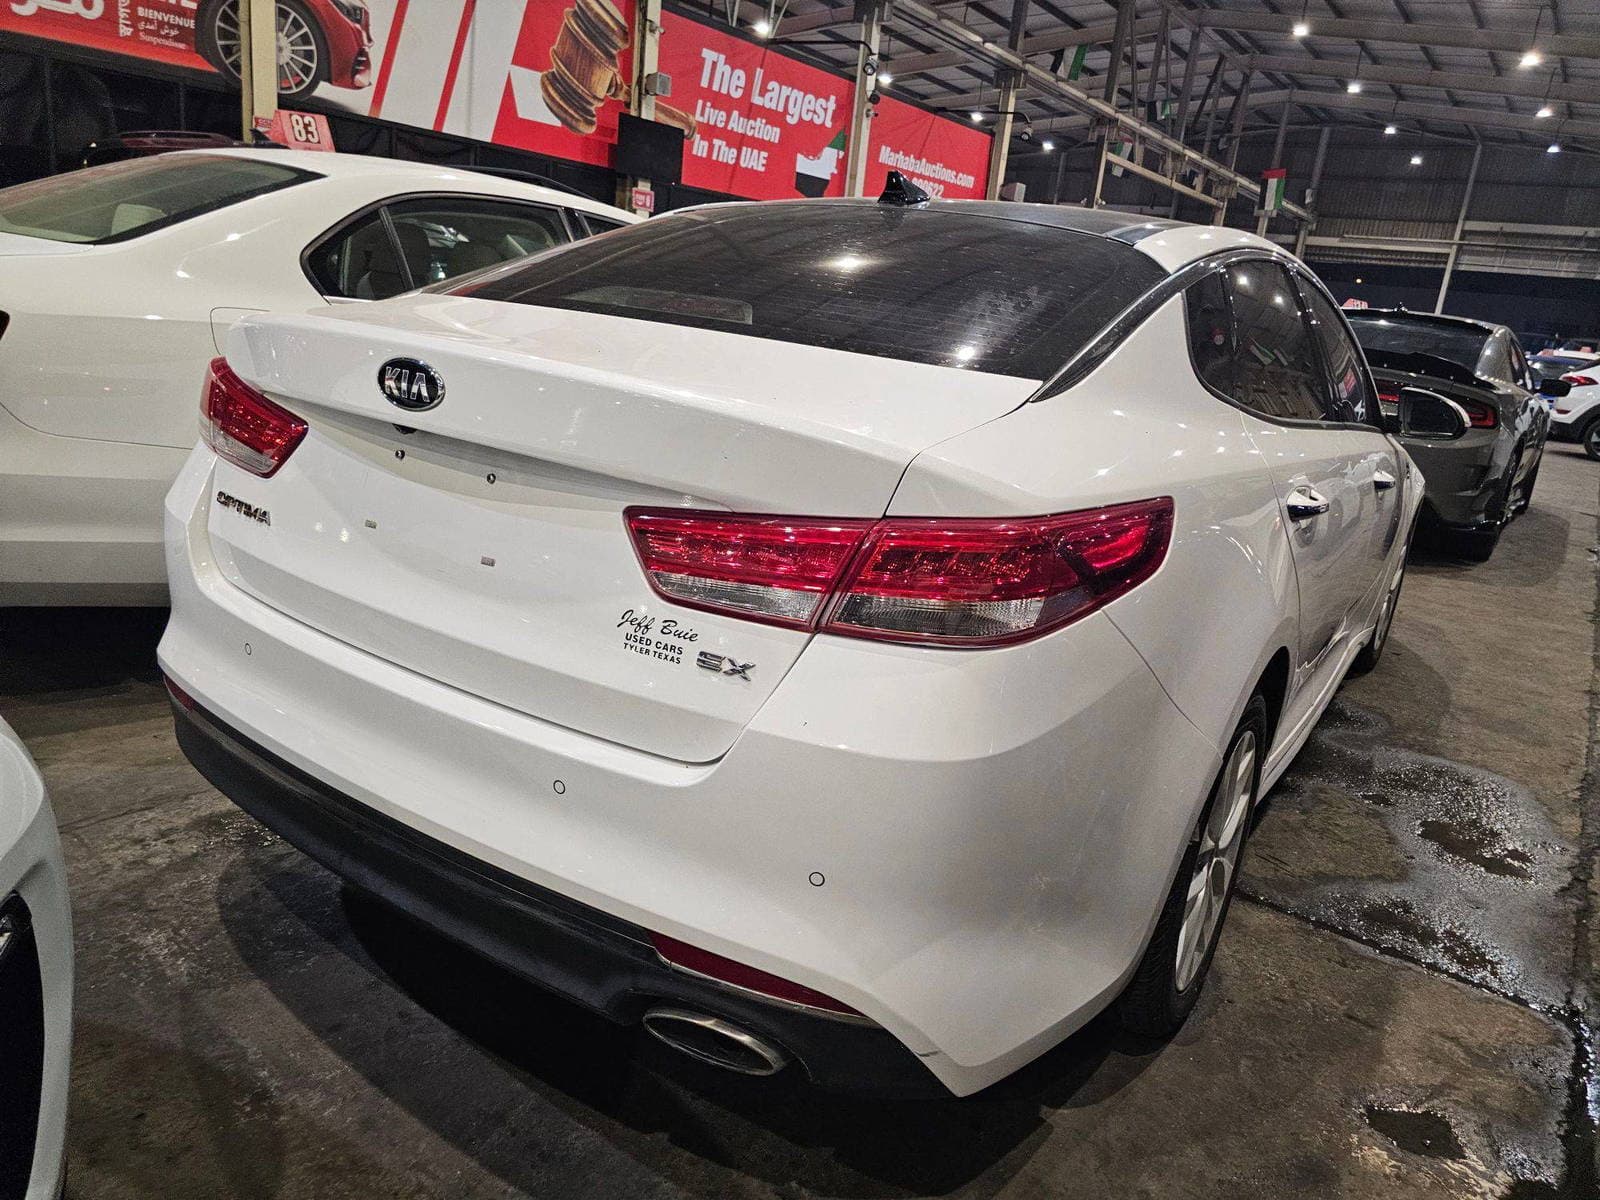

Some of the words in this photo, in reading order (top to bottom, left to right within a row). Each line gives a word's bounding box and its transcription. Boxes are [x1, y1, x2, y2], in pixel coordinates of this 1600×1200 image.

[137, 6, 196, 29] BIENVENUE
[700, 47, 746, 99] The
[750, 67, 836, 129] Largest
[290, 113, 320, 144] 83
[695, 99, 727, 128] Live
[727, 110, 781, 144] Auction
[692, 133, 709, 158] In
[711, 138, 738, 165] The
[739, 146, 769, 172] UAE
[878, 144, 975, 189] MarhabaAuctions.com
[384, 366, 430, 403] KIA
[216, 490, 271, 527] OPTIMA
[616, 609, 656, 635] Jeff
[660, 619, 699, 643] Buie
[625, 632, 652, 647] USED
[655, 641, 684, 655] CARS
[623, 642, 650, 656] TYLER
[652, 650, 681, 665] TEXAS
[696, 650, 756, 682] EX
